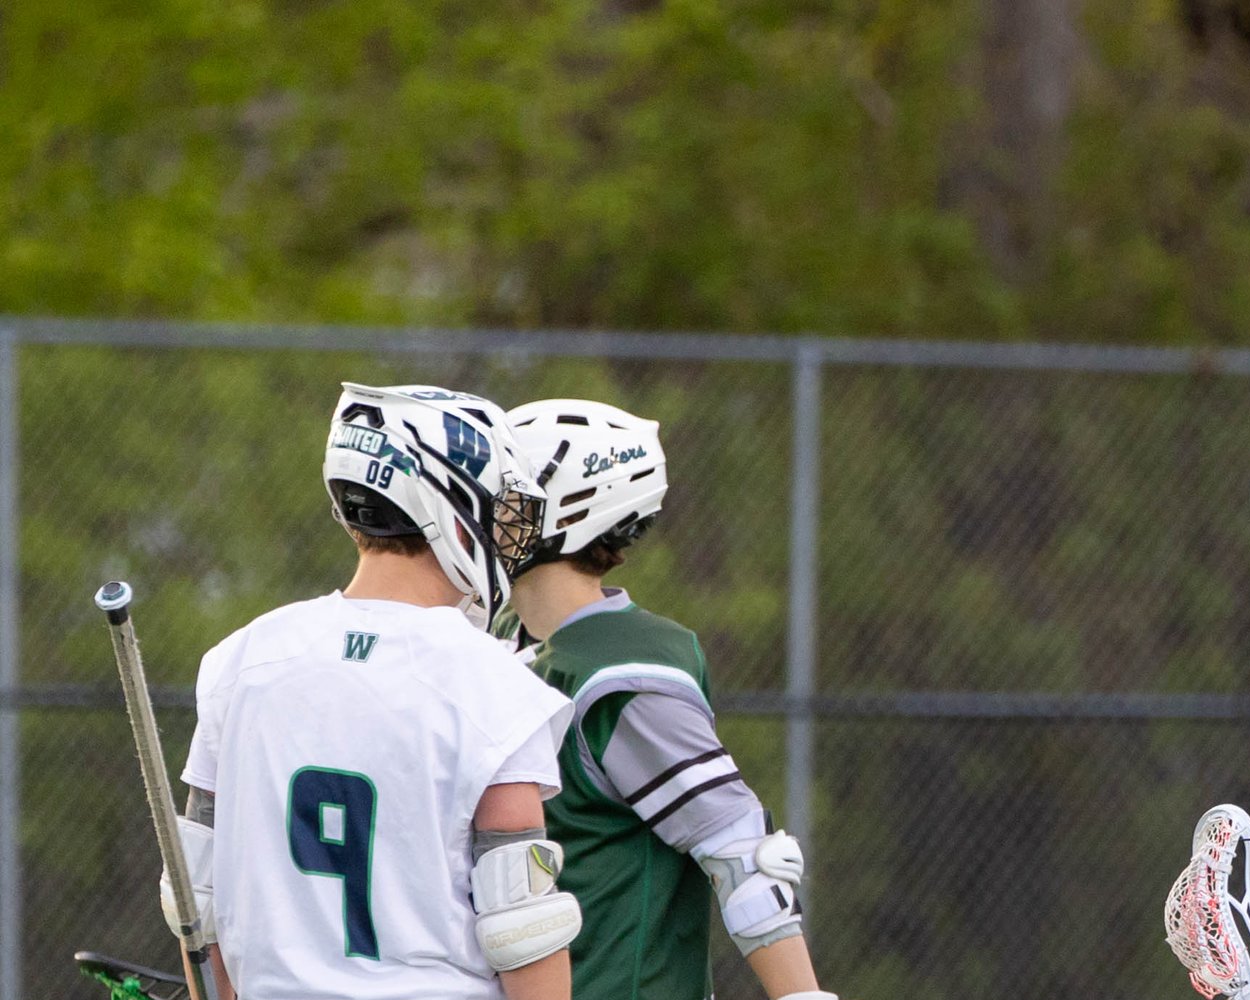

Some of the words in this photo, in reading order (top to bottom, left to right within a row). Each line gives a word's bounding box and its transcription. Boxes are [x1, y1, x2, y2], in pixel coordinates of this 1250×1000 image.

[366, 460, 394, 490] 09
[341, 631, 380, 663] W
[286, 765, 381, 961] 9
